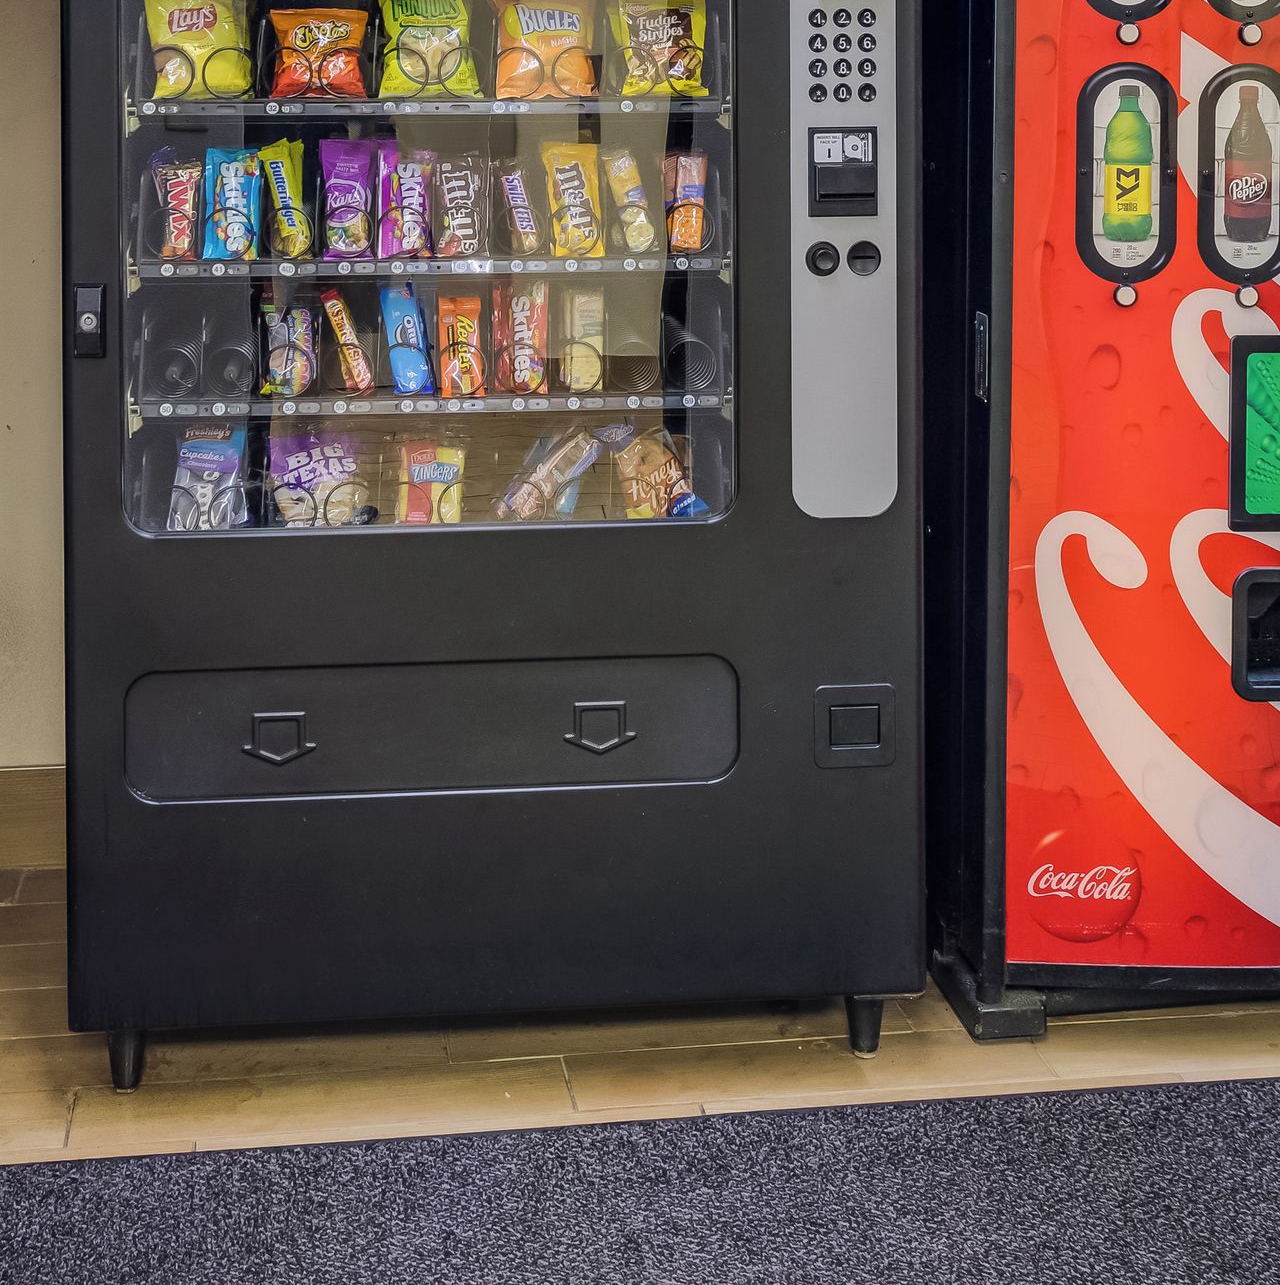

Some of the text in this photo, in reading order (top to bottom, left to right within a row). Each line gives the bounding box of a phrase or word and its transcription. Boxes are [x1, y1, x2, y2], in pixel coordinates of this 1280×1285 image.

[171, 6, 215, 33] Lay's
[515, 3, 581, 36] BUGLES
[637, 15, 682, 30] Fudge
[839, 12, 846, 24] 2
[863, 12, 872, 24] 3
[295, 21, 351, 50] Cheetos
[550, 36, 579, 47] NACHO
[638, 26, 684, 43] Stripes
[813, 37, 872, 49] 4 5 6
[815, 62, 871, 73] 7 8 9
[839, 87, 846, 99] 0
[268, 160, 298, 229] Butterfinger
[1232, 177, 1266, 201] Pepper
[1242, 176, 1257, 187] Dr
[167, 172, 196, 246] TWIX
[220, 161, 246, 252] Skittles
[327, 187, 361, 211] Kar's
[397, 162, 424, 250] Skittles
[505, 176, 534, 232] SNICKERS
[455, 315, 475, 371] Reese's
[511, 296, 534, 383] Skittles
[185, 427, 232, 439] Freshley's
[179, 448, 225, 462] Cupcakes
[187, 460, 217, 468] Chocolate
[286, 443, 345, 470] BIG
[282, 457, 357, 485] TEXAS
[628, 459, 683, 502] Honey
[1027, 863, 1138, 901] Coca-Cola
